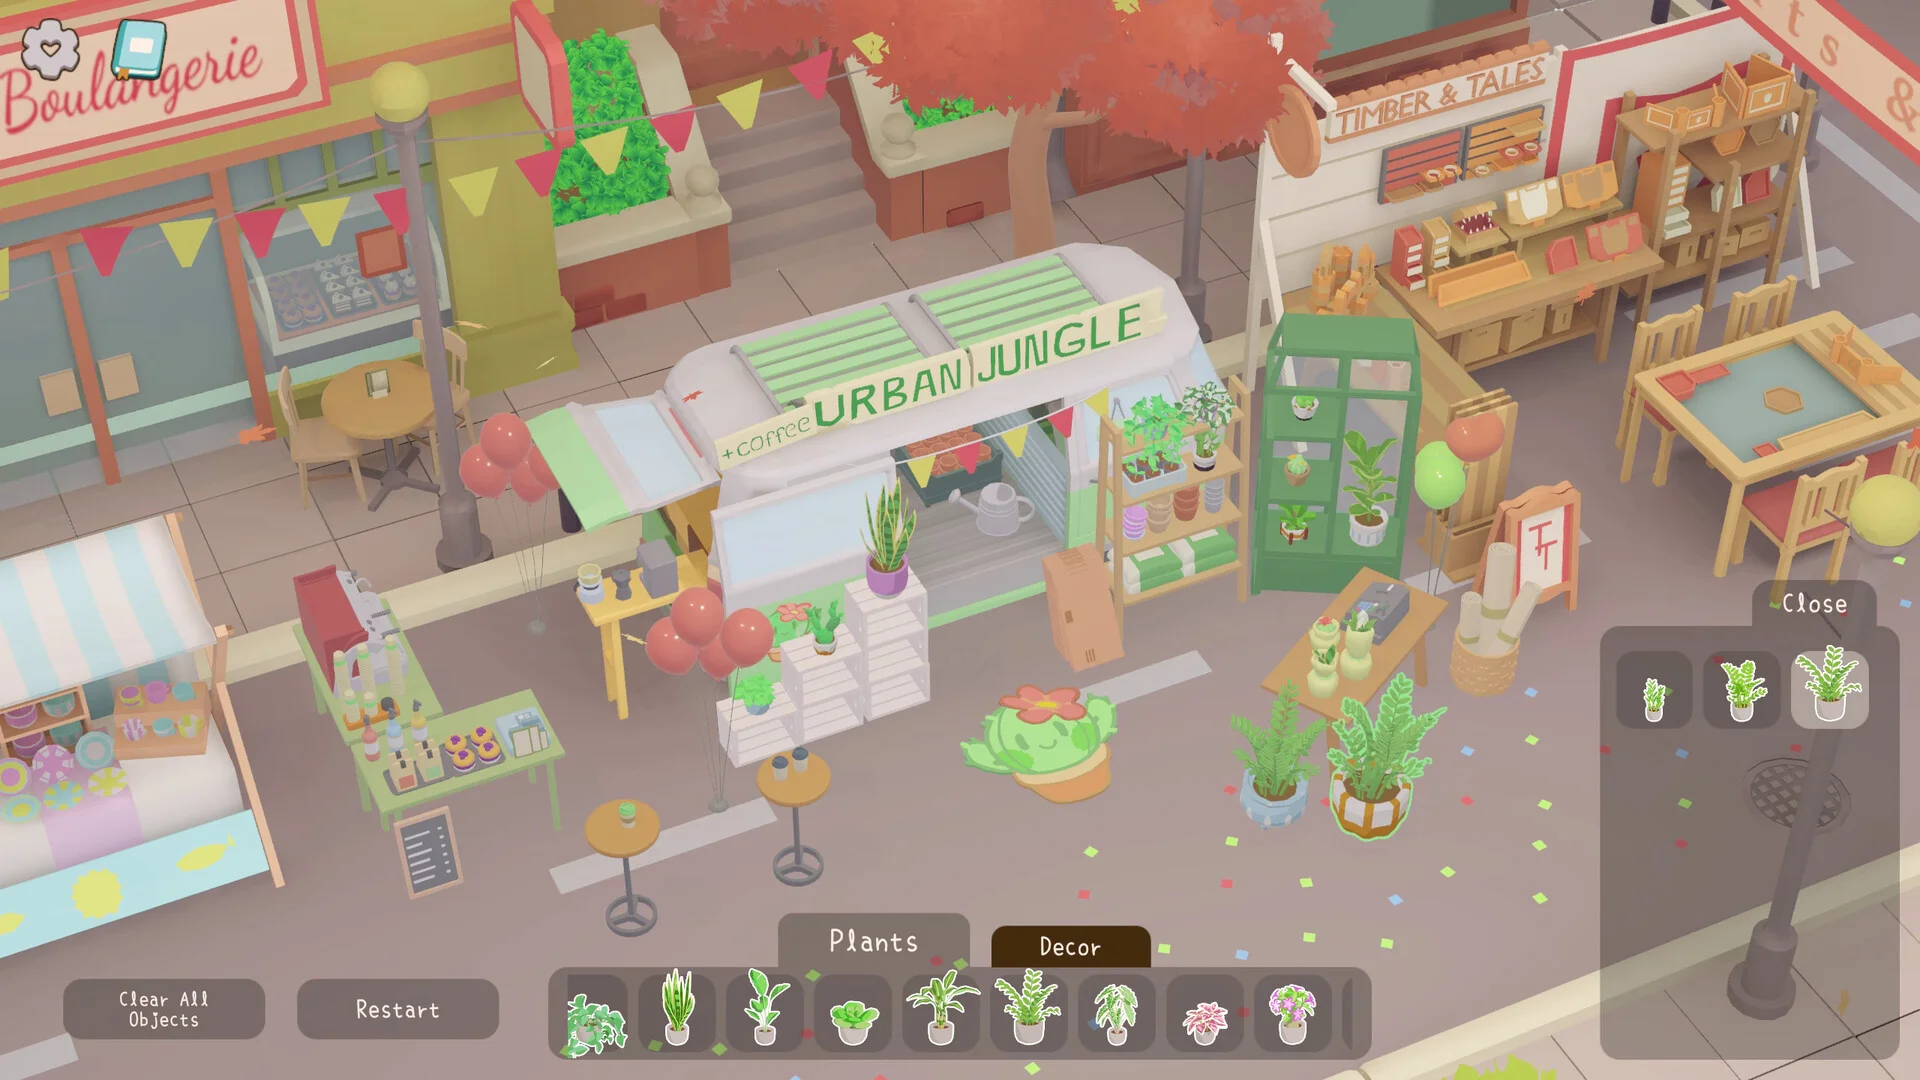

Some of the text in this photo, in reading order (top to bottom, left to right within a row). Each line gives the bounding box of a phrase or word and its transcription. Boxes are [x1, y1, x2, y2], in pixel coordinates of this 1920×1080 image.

[0, 36, 263, 135] Boulangerie
[1335, 56, 1546, 135] TIMBER & TALES
[815, 358, 961, 428] URBAN
[977, 303, 1142, 384] JUNGLE
